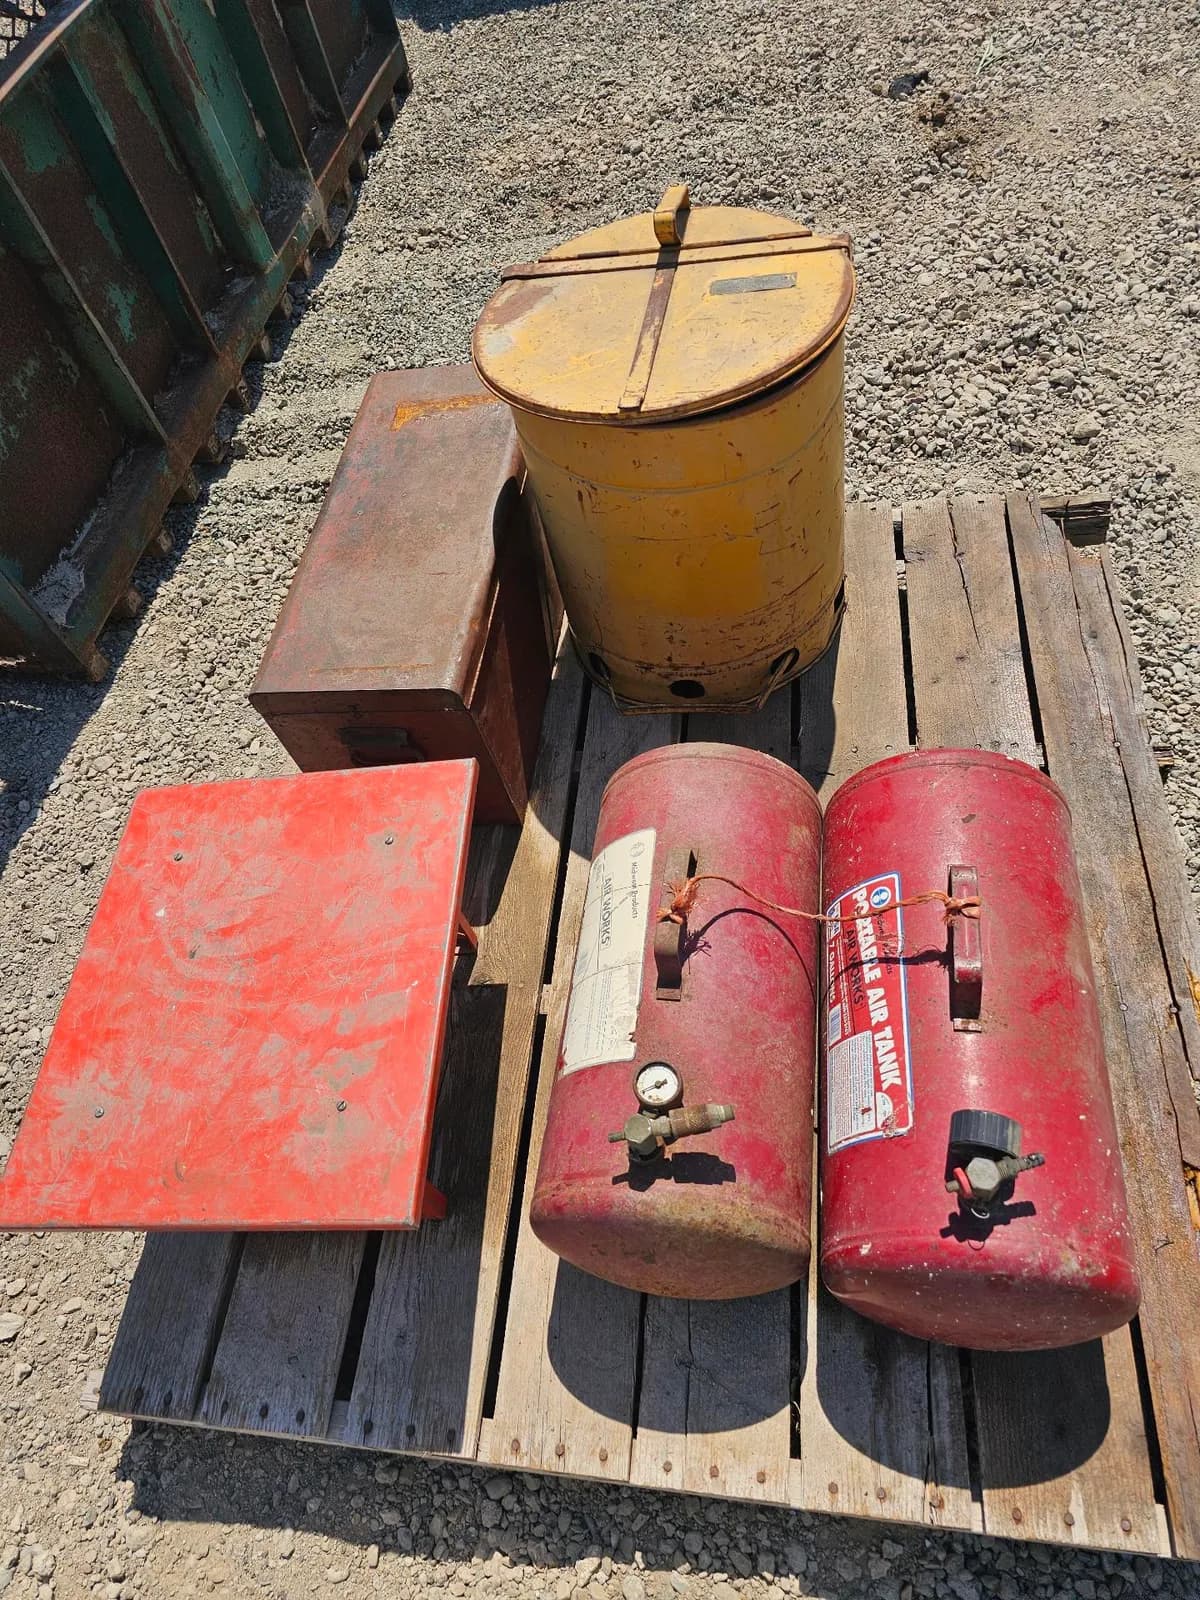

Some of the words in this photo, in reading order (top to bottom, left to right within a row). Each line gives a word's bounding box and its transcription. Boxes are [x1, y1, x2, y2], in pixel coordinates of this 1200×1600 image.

[603, 877, 612, 897] AIR
[601, 897, 612, 945] WORKS
[847, 929, 857, 951] AIR
[852, 887, 882, 984] PORTABLE
[849, 953, 864, 1004] WORKS
[866, 987, 890, 1026] AIR
[873, 1026, 902, 1091] TANK
